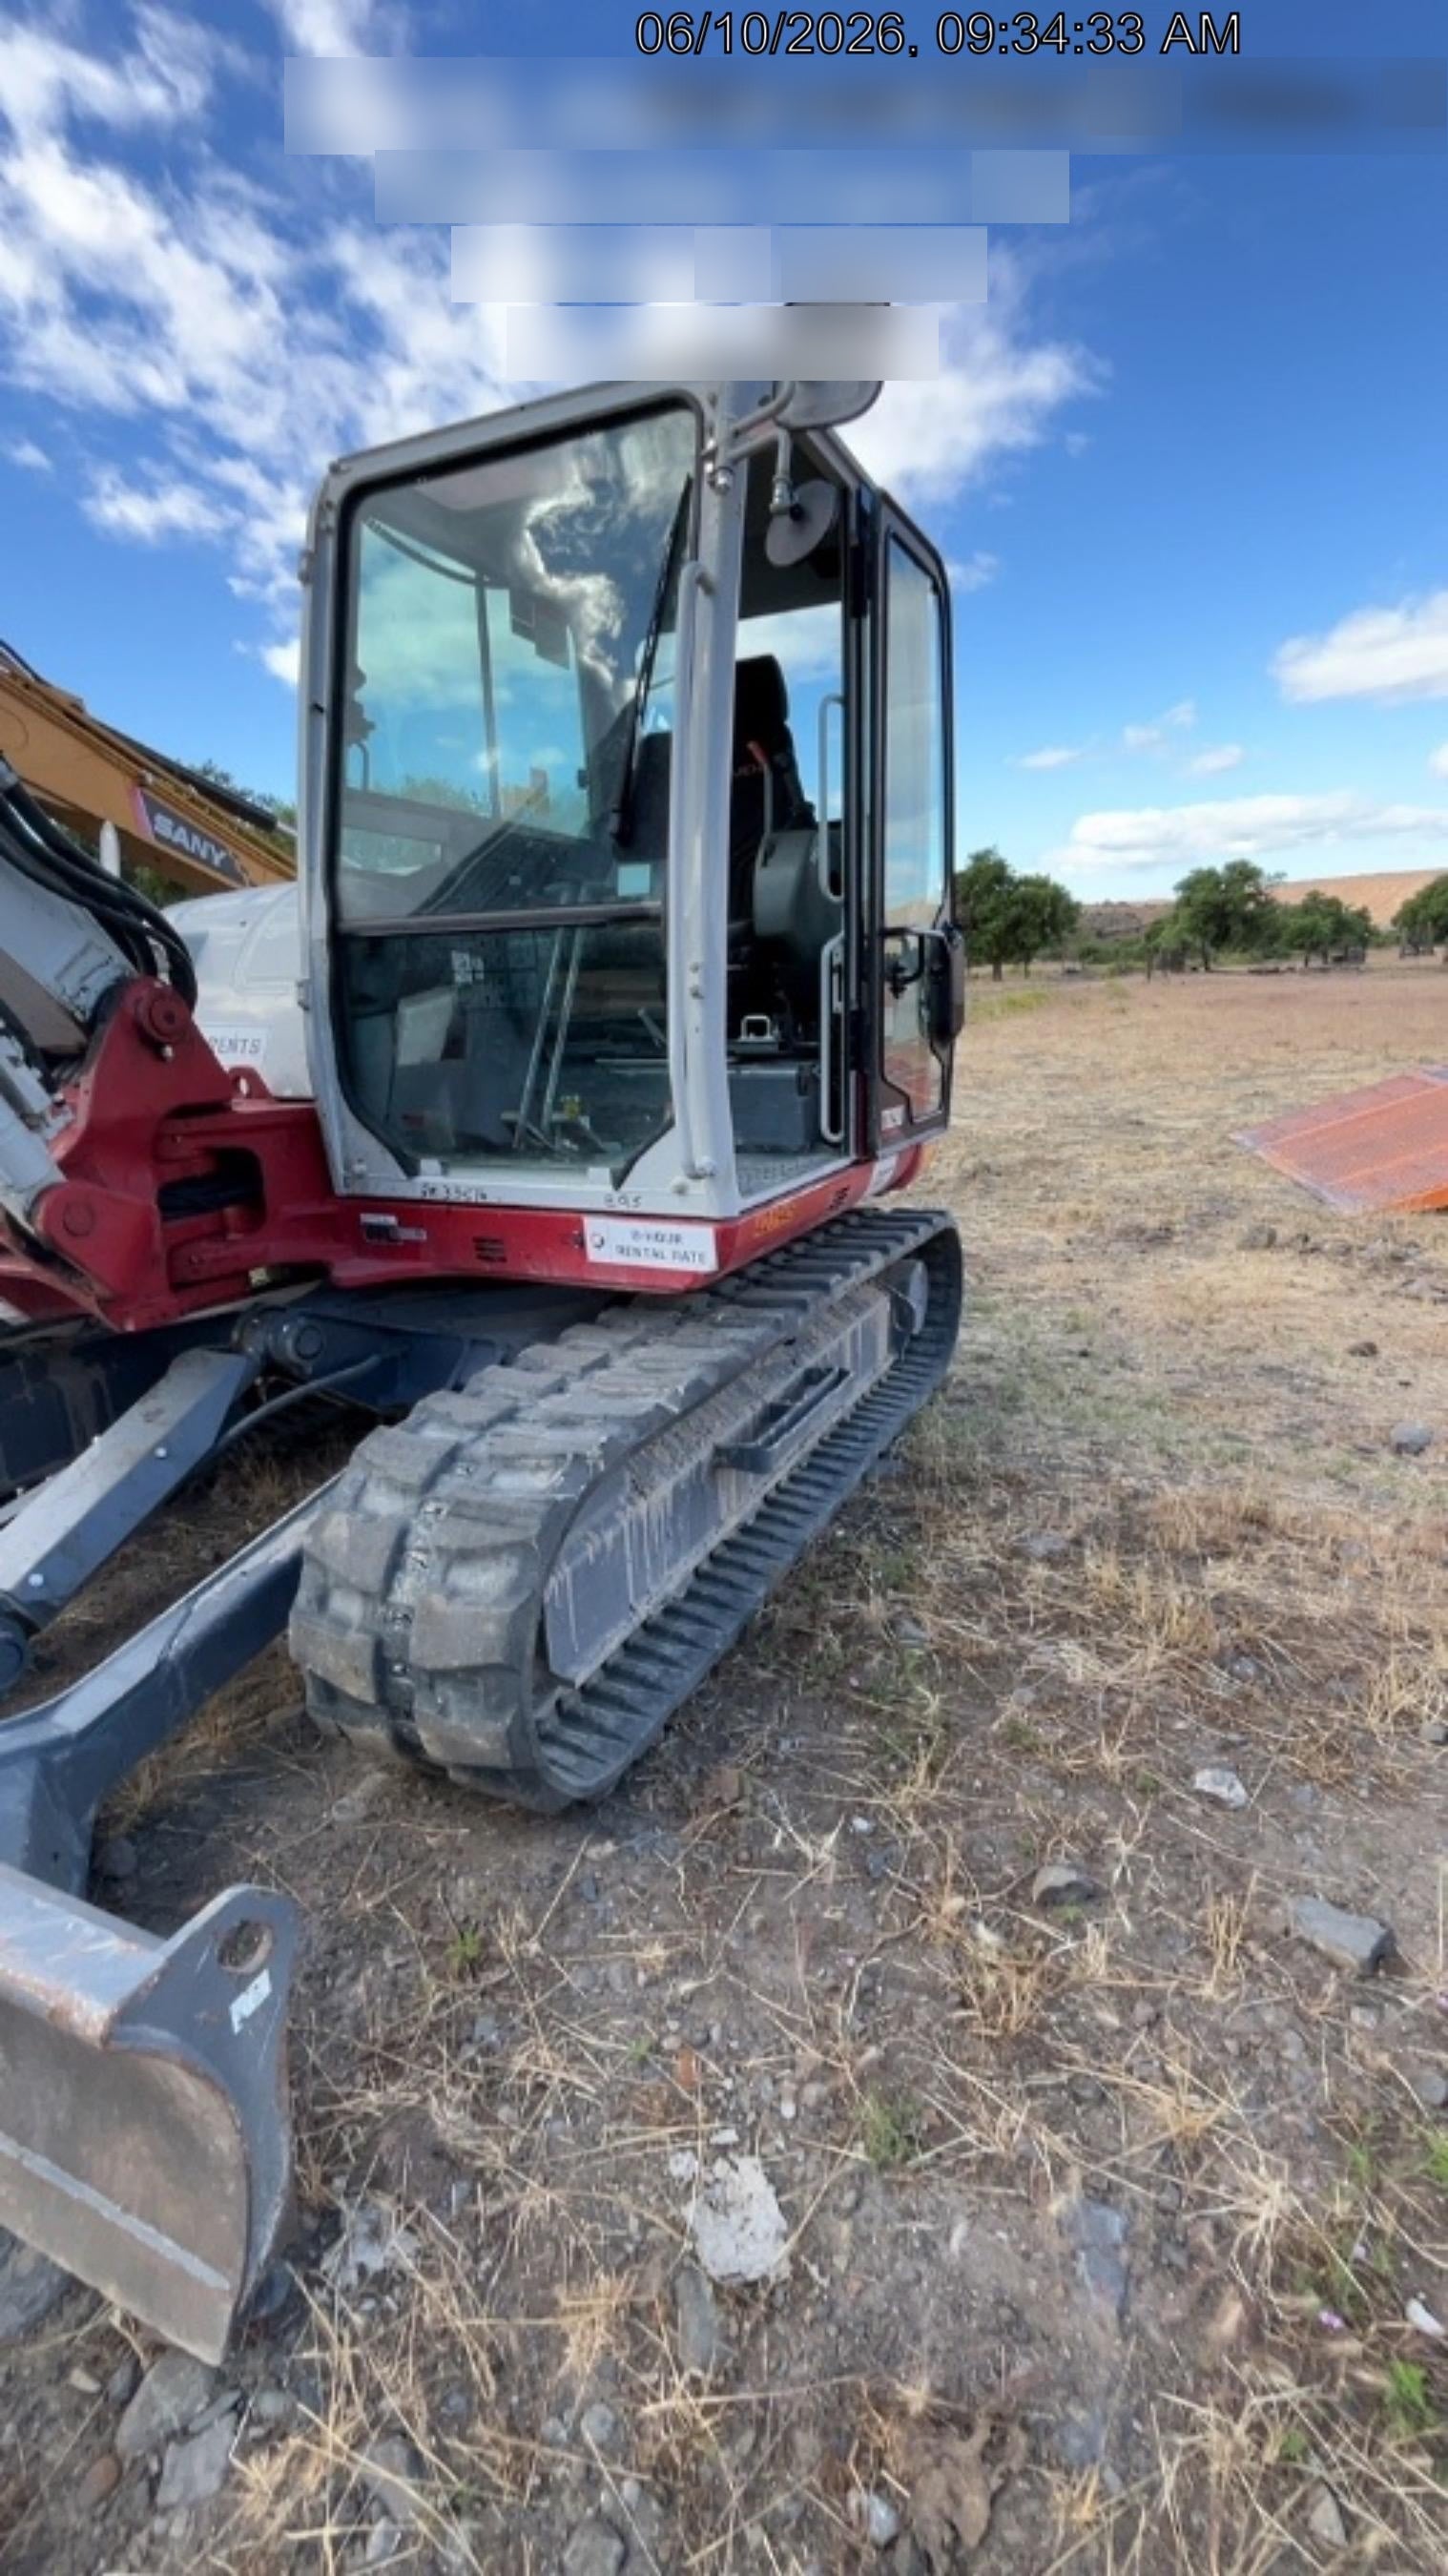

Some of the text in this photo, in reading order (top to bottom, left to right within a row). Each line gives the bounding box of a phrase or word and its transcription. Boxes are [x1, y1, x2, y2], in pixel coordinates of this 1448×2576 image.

[154, 813, 227, 867] SANY
[615, 1244, 707, 1265] RENTAL RATE
